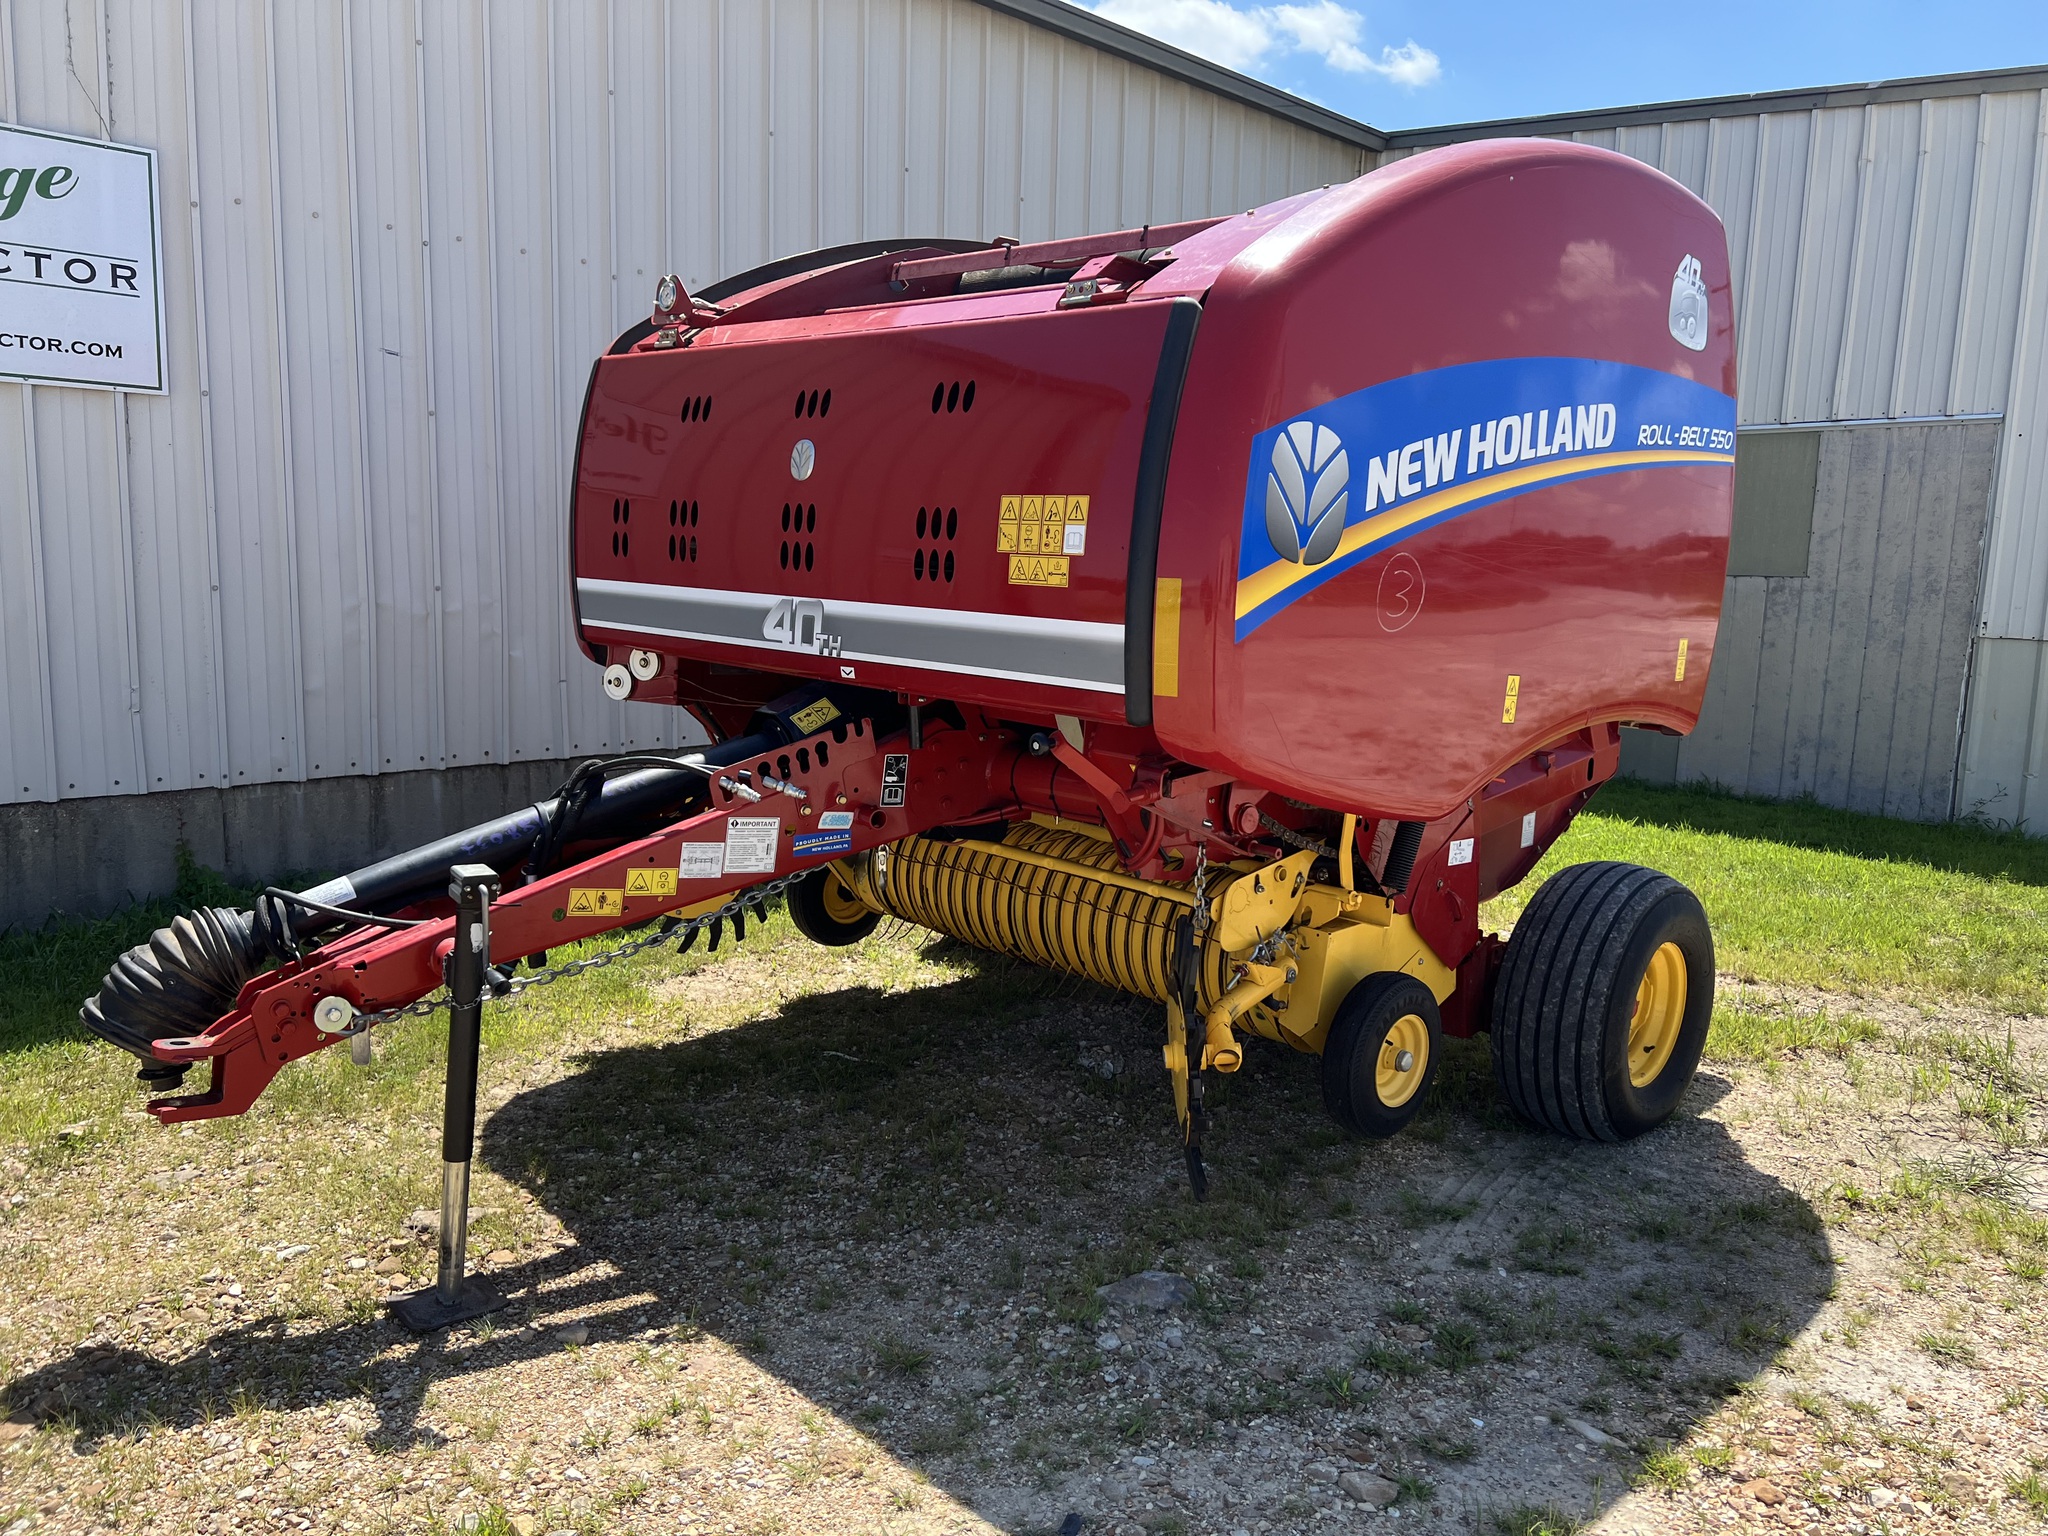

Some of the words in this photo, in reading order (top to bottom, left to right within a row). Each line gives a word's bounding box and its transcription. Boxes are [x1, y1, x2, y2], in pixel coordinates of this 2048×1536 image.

[1709, 428, 1734, 450] 550
[1365, 428, 1463, 512] NEW
[1467, 403, 1617, 475] HOLLAND
[1386, 569, 1415, 618] 3
[795, 837, 823, 847] PROUDLY
